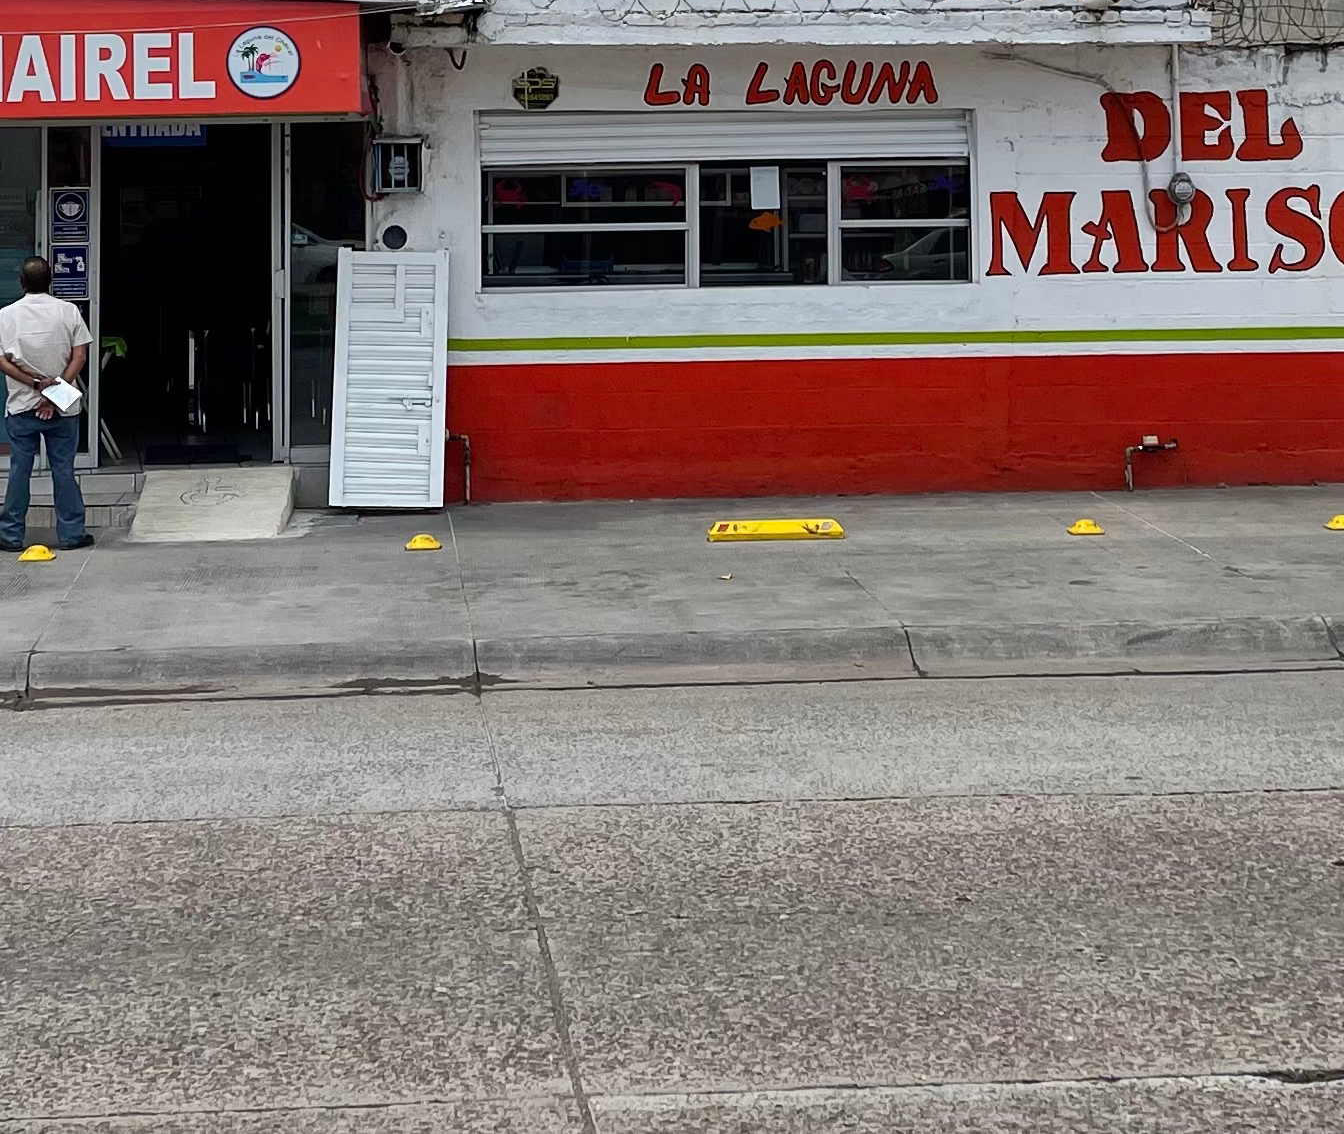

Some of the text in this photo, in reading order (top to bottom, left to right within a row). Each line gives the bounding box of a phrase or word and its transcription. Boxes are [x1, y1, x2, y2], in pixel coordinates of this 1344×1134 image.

[643, 59, 939, 107] LA LAGUNA
[1099, 87, 1304, 163] DEL
